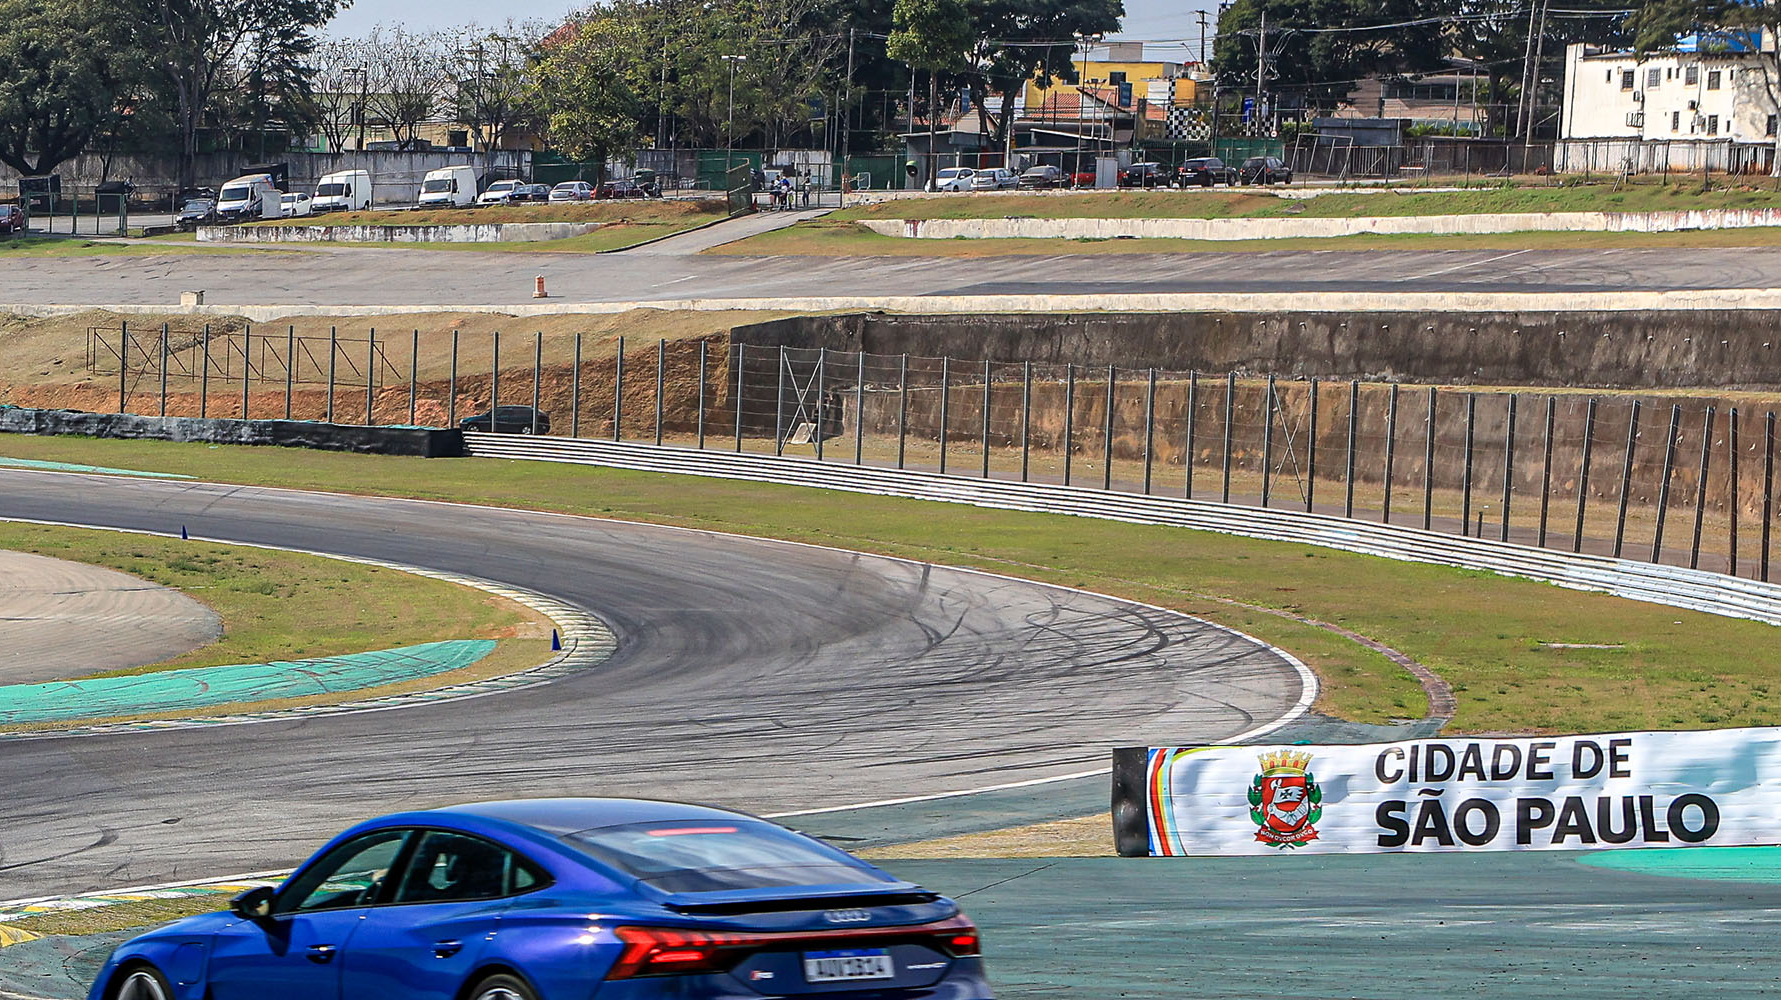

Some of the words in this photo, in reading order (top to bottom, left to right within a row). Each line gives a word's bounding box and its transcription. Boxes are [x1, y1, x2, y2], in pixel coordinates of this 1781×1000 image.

[1374, 741, 1556, 784] CIDADE
[1571, 738, 1632, 781] DE
[1375, 788, 1501, 847] SÃO
[1516, 792, 1720, 845] PAULO
